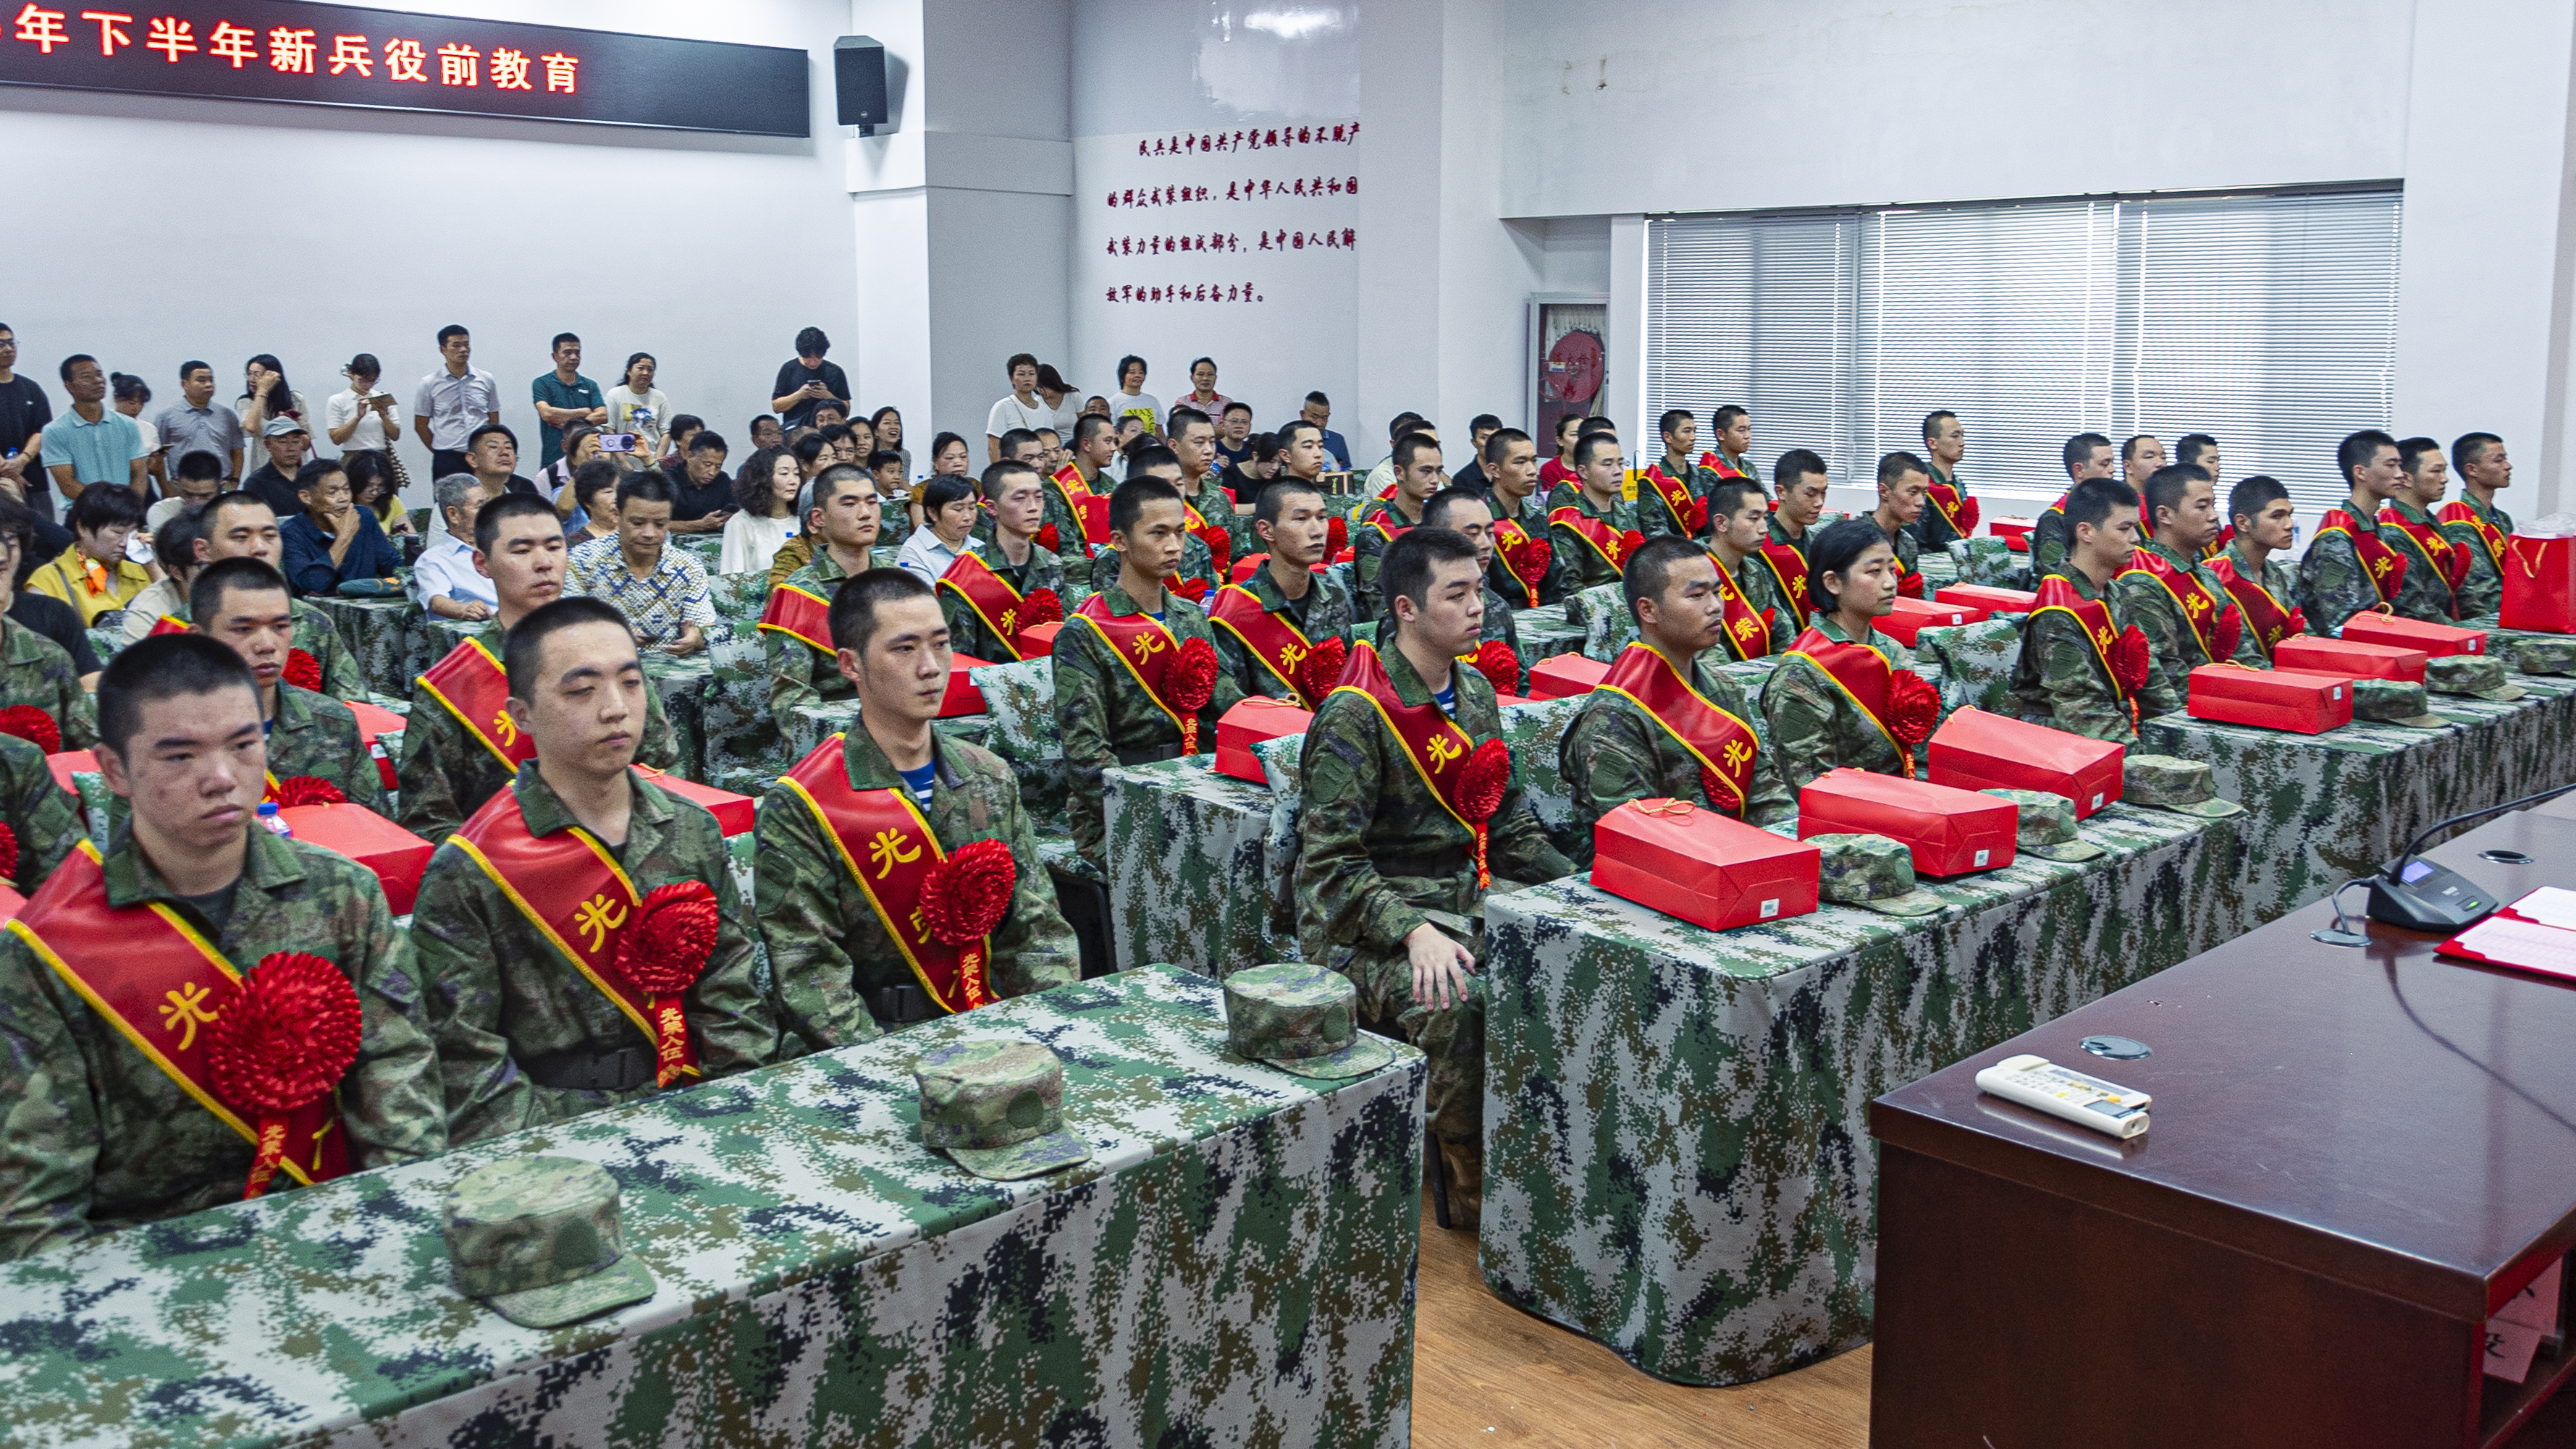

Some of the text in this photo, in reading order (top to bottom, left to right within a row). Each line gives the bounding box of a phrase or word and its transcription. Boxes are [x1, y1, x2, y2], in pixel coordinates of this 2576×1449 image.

[14, 2, 579, 93] 年下半年新兵役前教育
[1065, 479, 1085, 495] 光
[1501, 531, 1523, 552] 光
[2375, 557, 2394, 579] 光
[2186, 592, 2209, 619] 光
[1132, 631, 1166, 665] 光
[2097, 626, 2113, 655] 光
[1279, 643, 1306, 675] 光
[1426, 733, 1462, 774] 光
[1723, 739, 1752, 778] 光
[869, 827, 922, 879] 光
[574, 894, 627, 953] 光
[159, 981, 220, 1051] 光
